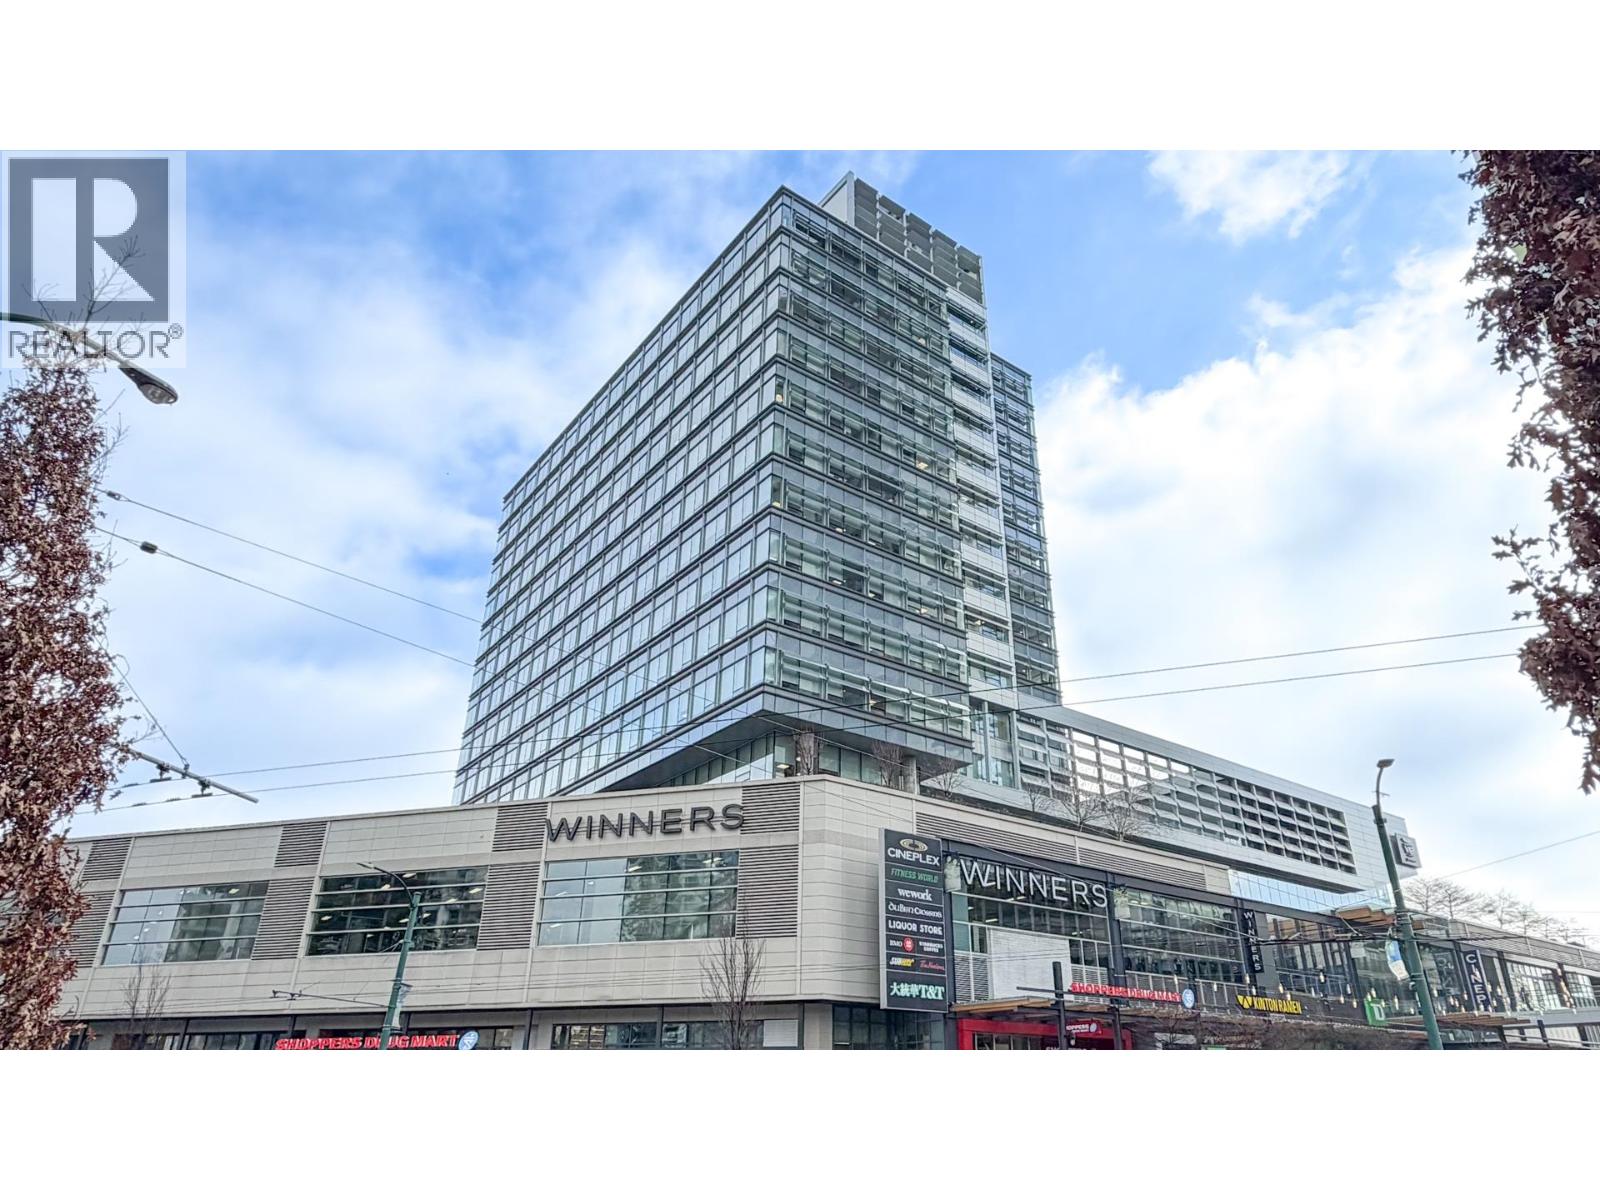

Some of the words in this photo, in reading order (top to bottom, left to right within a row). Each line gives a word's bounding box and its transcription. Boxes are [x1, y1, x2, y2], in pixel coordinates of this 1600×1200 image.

[544, 803, 745, 842] WINNERS
[887, 847, 940, 866] CINEPLEX
[891, 868, 917, 880] FITNESS
[917, 872, 939, 883] WORLD
[960, 858, 1108, 908] WINNERS
[897, 888, 932, 901] wework
[888, 920, 918, 932] LIQUOR
[919, 925, 943, 936] STORE
[1243, 911, 1262, 971] WINNERS
[1253, 996, 1279, 1012] KINTON
[1278, 999, 1302, 1014] RAMEN
[275, 1037, 363, 1050] SHOPPERS
[411, 1035, 459, 1048] MART
